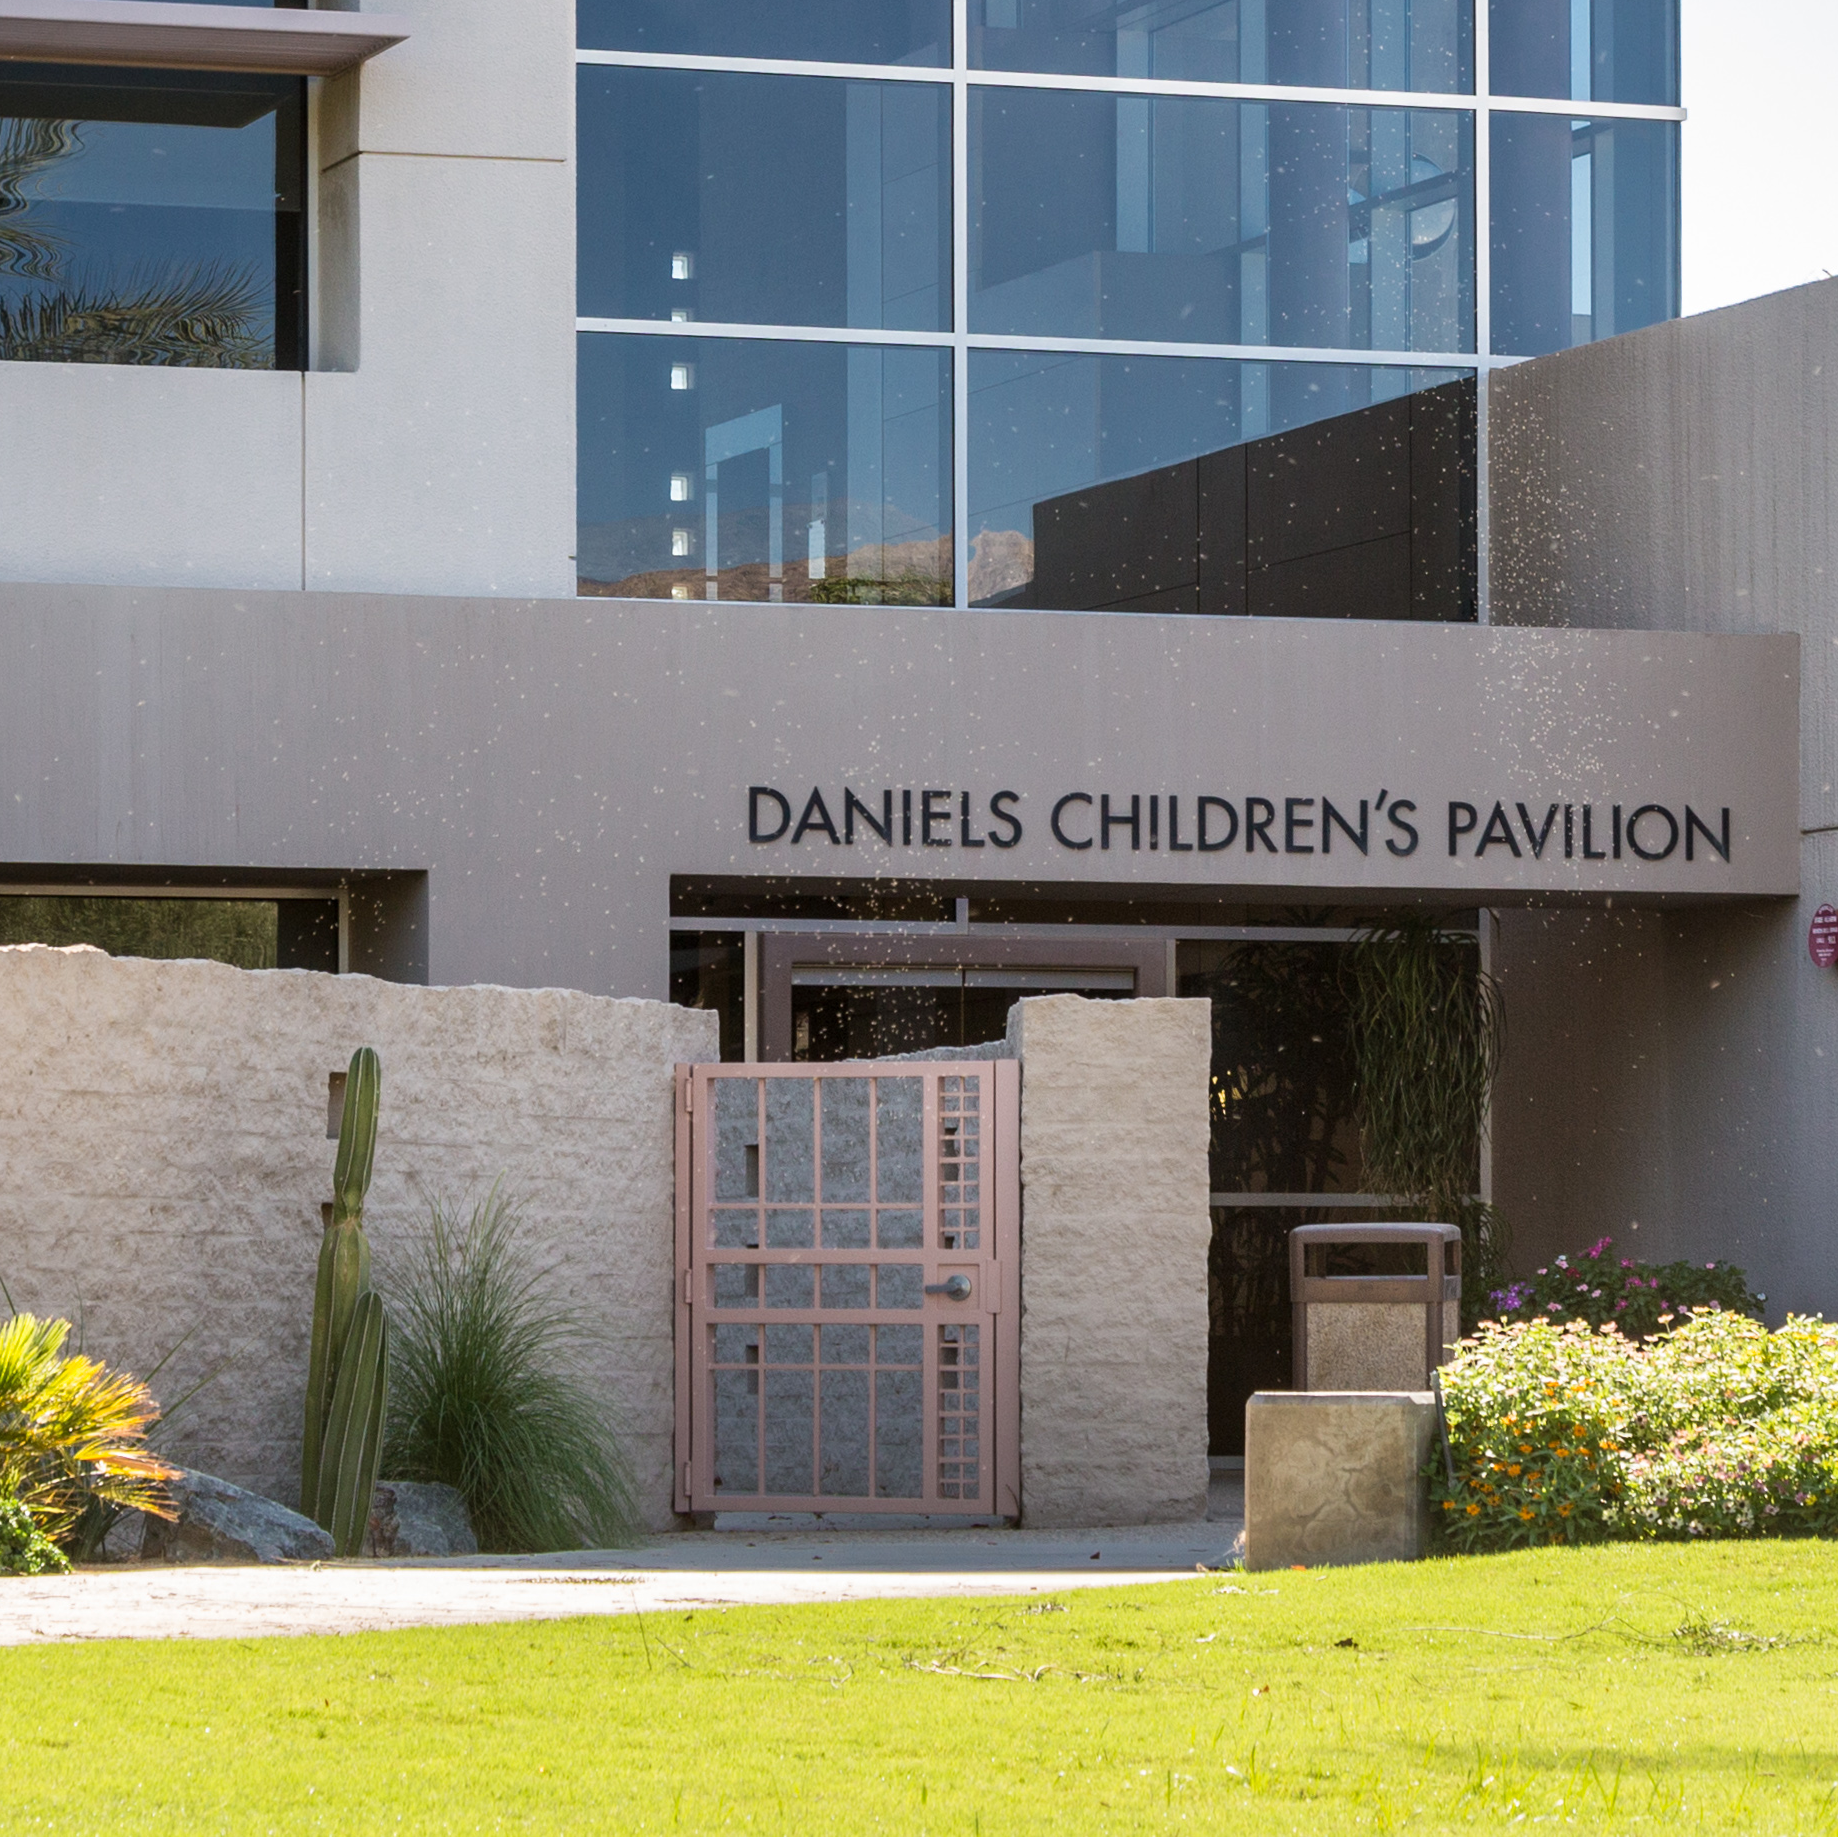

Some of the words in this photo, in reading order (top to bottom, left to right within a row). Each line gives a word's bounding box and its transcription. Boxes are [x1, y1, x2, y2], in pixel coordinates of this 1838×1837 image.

[747, 786, 1024, 850] DANIELS
[1049, 788, 1420, 859] CHILDREN'S
[1447, 800, 1732, 865] PAVILION
